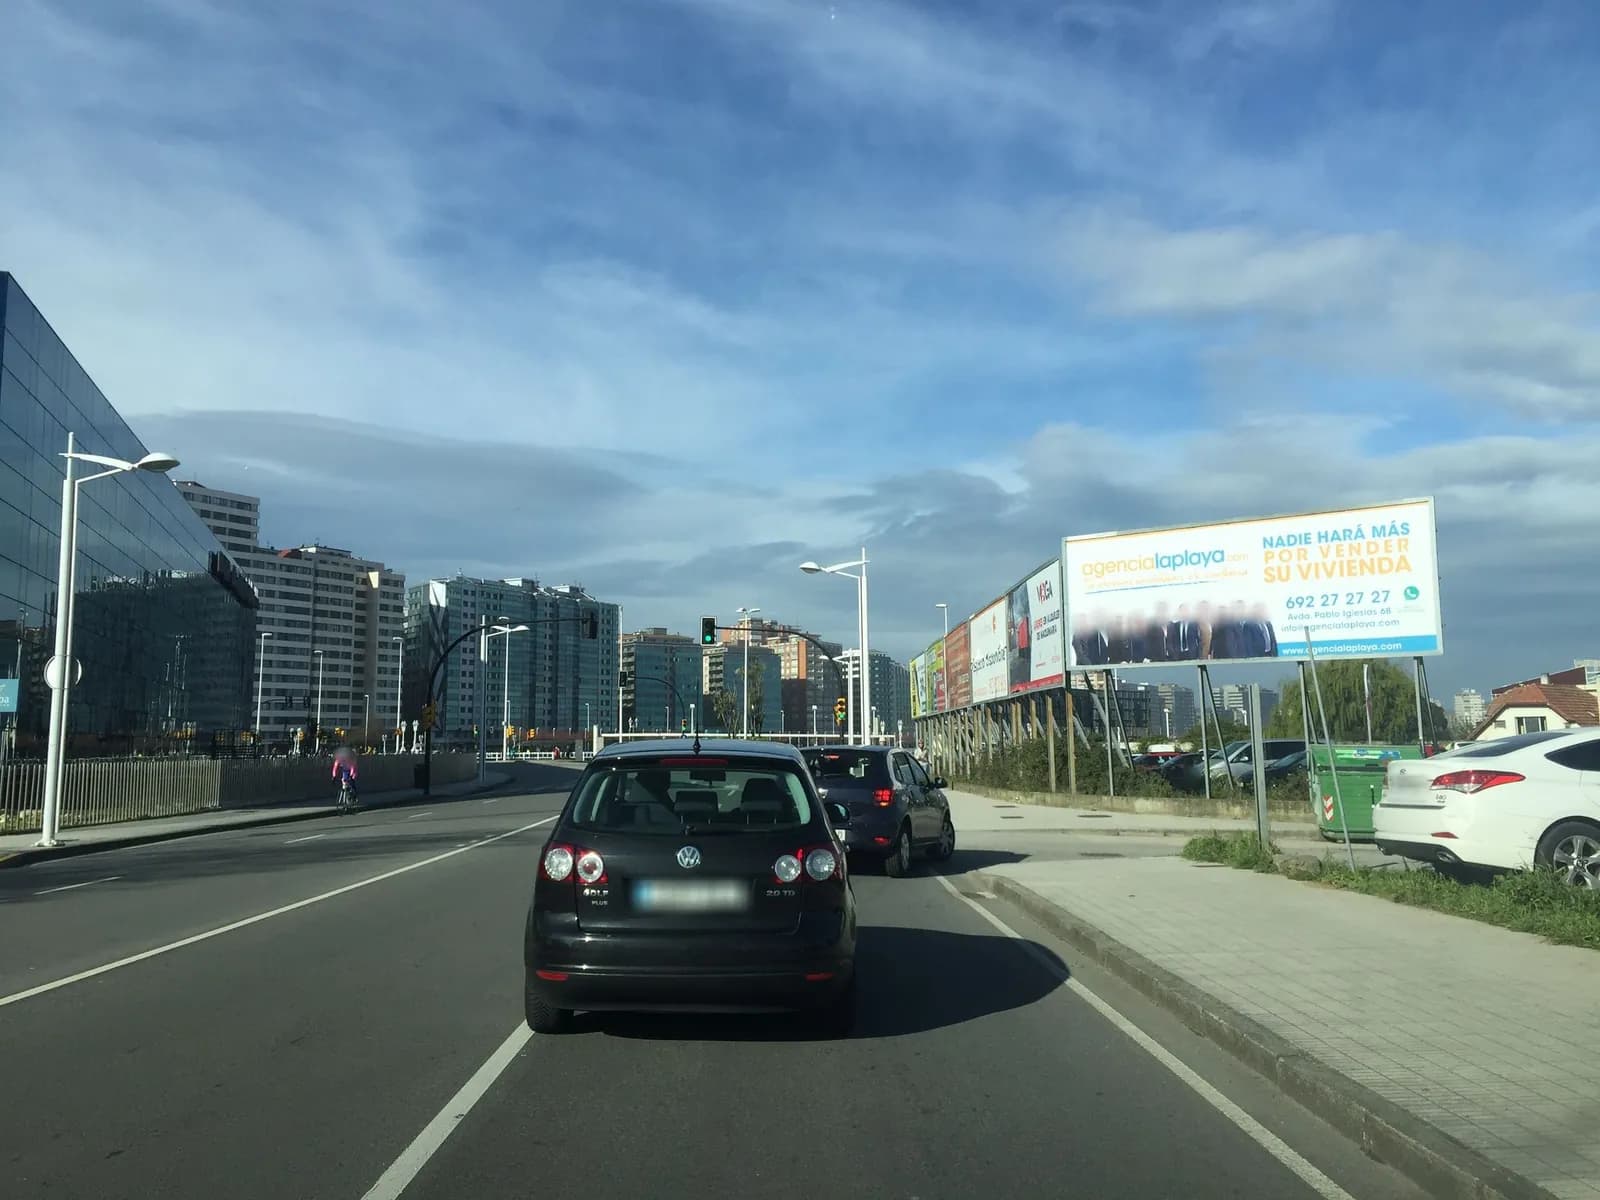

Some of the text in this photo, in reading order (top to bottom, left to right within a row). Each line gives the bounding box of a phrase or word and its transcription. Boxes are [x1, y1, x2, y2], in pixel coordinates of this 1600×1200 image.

[1263, 520, 1411, 549] NADIE HARÁ MÁS
[1264, 538, 1409, 564] POR VENDER
[1264, 565, 1291, 583] SU
[1296, 555, 1412, 580] VIVIENDA
[1286, 590, 1391, 609] 692 27 27 27
[1314, 610, 1340, 619] Pablo
[1343, 608, 1377, 619] Iglesias
[1281, 619, 1400, 633] info@gencialaplaya.com
